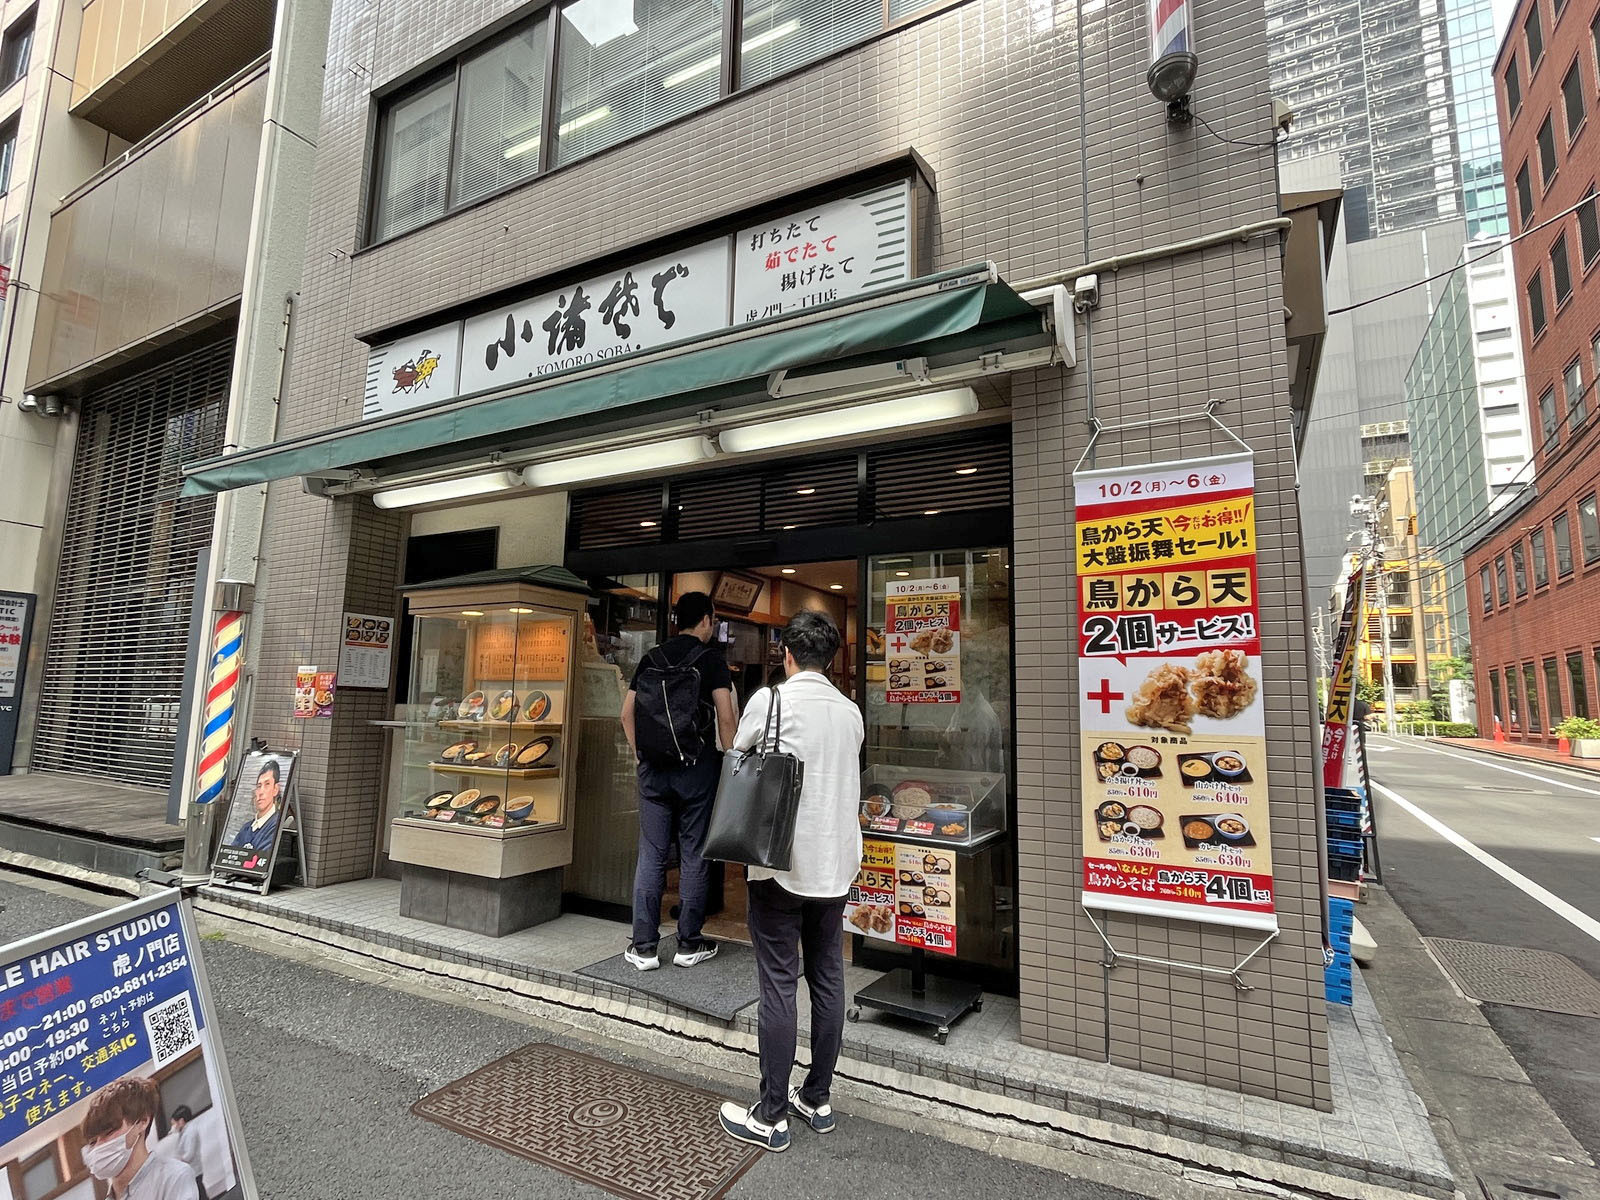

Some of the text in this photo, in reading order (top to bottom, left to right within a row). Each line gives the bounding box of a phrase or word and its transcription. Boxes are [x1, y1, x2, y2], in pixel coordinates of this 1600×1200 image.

[750, 215, 821, 252] 打ちたて
[764, 235, 838, 272] 茹でたて
[780, 256, 855, 292] 揚げたて
[536, 343, 632, 376] KOMORO SOBA
[1081, 516, 1164, 546] 鳥から天
[1083, 528, 1249, 568] 大盤振舞セール!
[1086, 571, 1249, 610] 鳥から天
[895, 603, 949, 617] 鳥から天
[1150, 736, 1189, 745] 対象商品
[1128, 786, 1158, 798] 610円
[1215, 791, 1248, 805] 640円
[1130, 845, 1160, 859] 630円
[1218, 853, 1251, 867] 630円
[1121, 863, 1149, 876] なんと
[1158, 871, 1208, 885] 鳥から天
[1087, 872, 1157, 893] 鳥からそば
[1175, 885, 1203, 899] 540円
[30, 941, 91, 979] HAIR
[95, 910, 171, 953] STUDIO
[112, 932, 181, 978] 虎ノ門店
[99, 991, 155, 1025] ネット予約は
[102, 1018, 131, 1039] こちら
[2, 1037, 90, 1095] 当日予約OK
